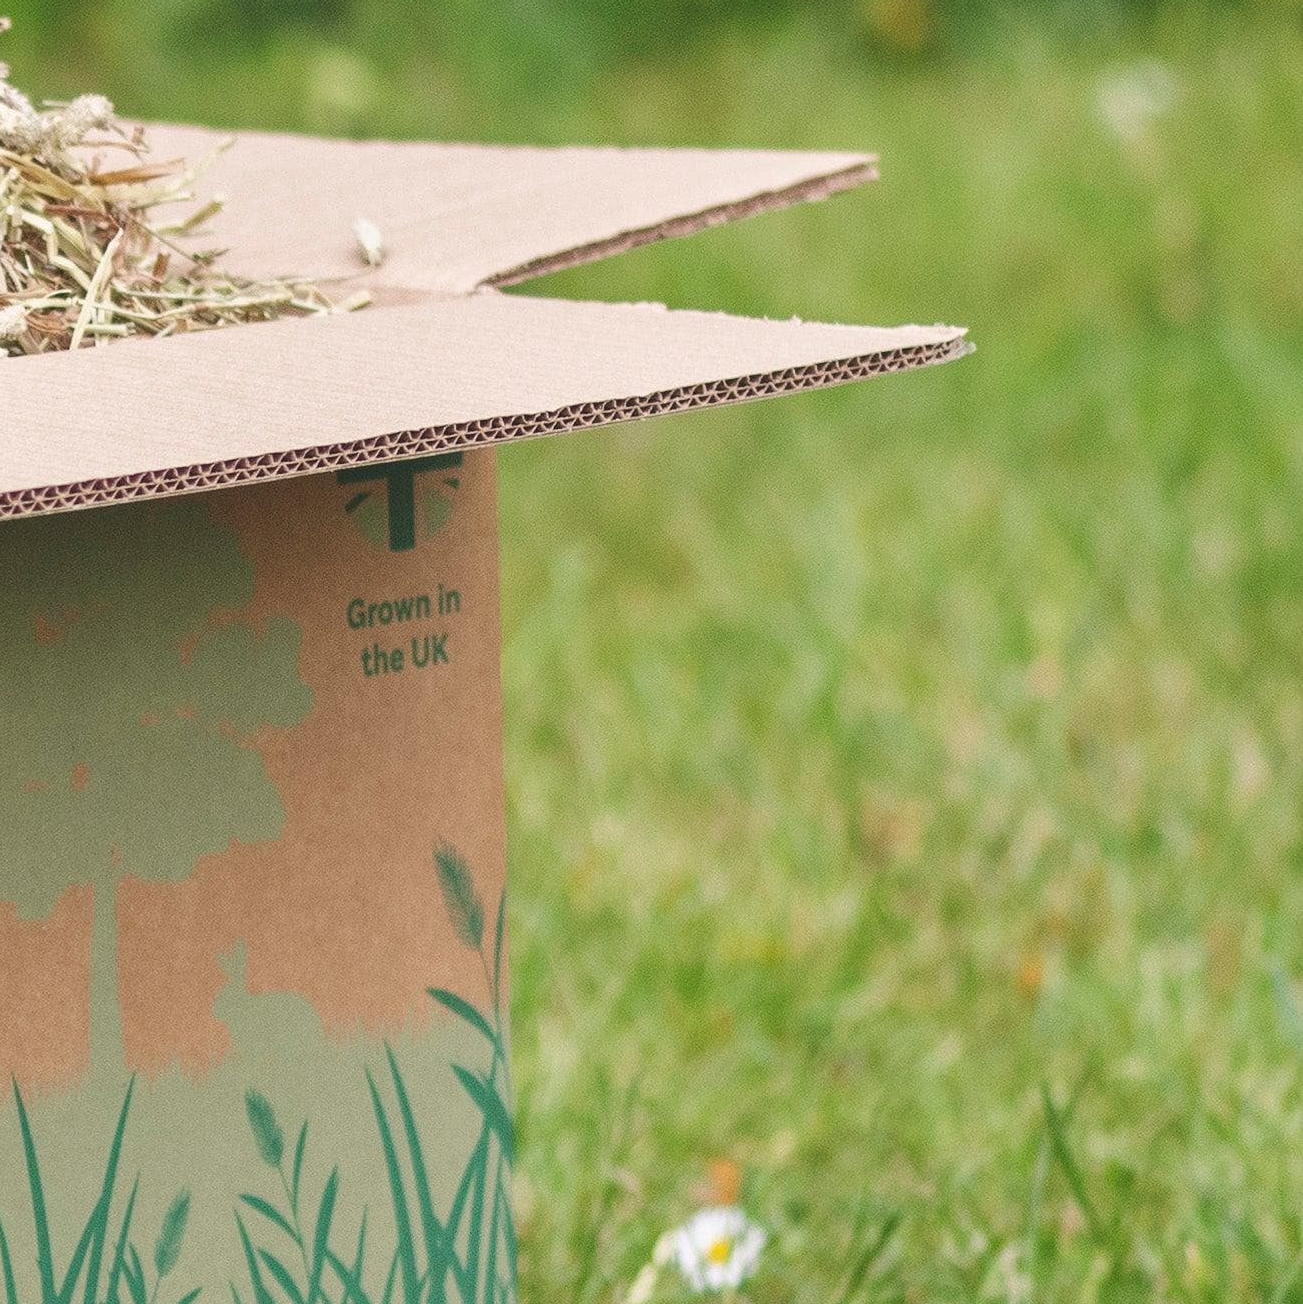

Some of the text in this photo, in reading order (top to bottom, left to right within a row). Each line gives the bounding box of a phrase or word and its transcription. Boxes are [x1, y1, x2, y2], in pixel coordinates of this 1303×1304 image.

[346, 583, 462, 630] Grown in
[360, 632, 449, 677] the UK
